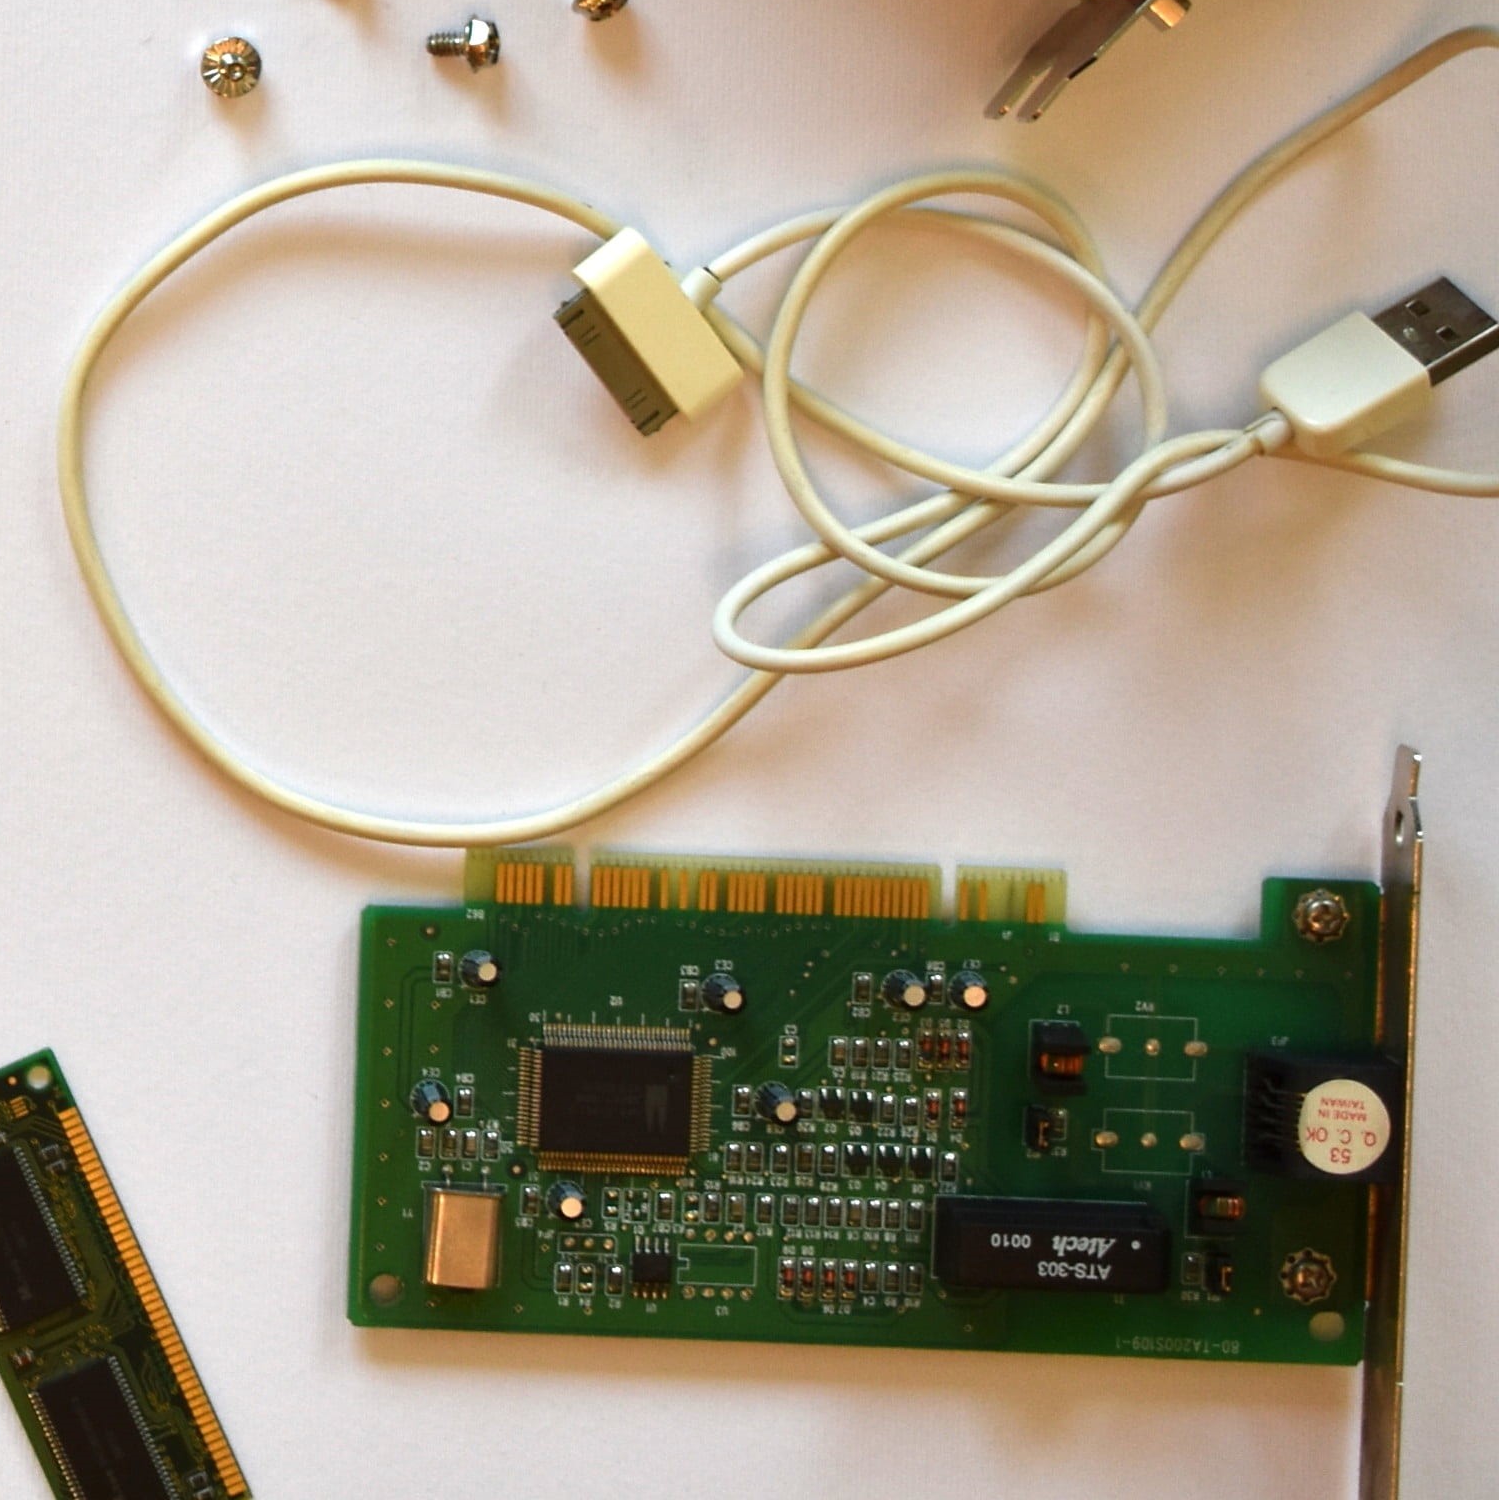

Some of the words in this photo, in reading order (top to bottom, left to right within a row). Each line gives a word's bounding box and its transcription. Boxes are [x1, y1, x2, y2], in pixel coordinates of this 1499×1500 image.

[1320, 1097, 1364, 1109] TAIWAN
[1318, 1109, 1328, 1117] IN
[1334, 1110, 1366, 1121] MADE
[1306, 1127, 1327, 1142] OK
[1330, 1147, 1351, 1164] 53
[989, 1232, 1031, 1248] 0010
[1051, 1235, 1116, 1258] Atech
[1037, 1260, 1111, 1280] ATS-303
